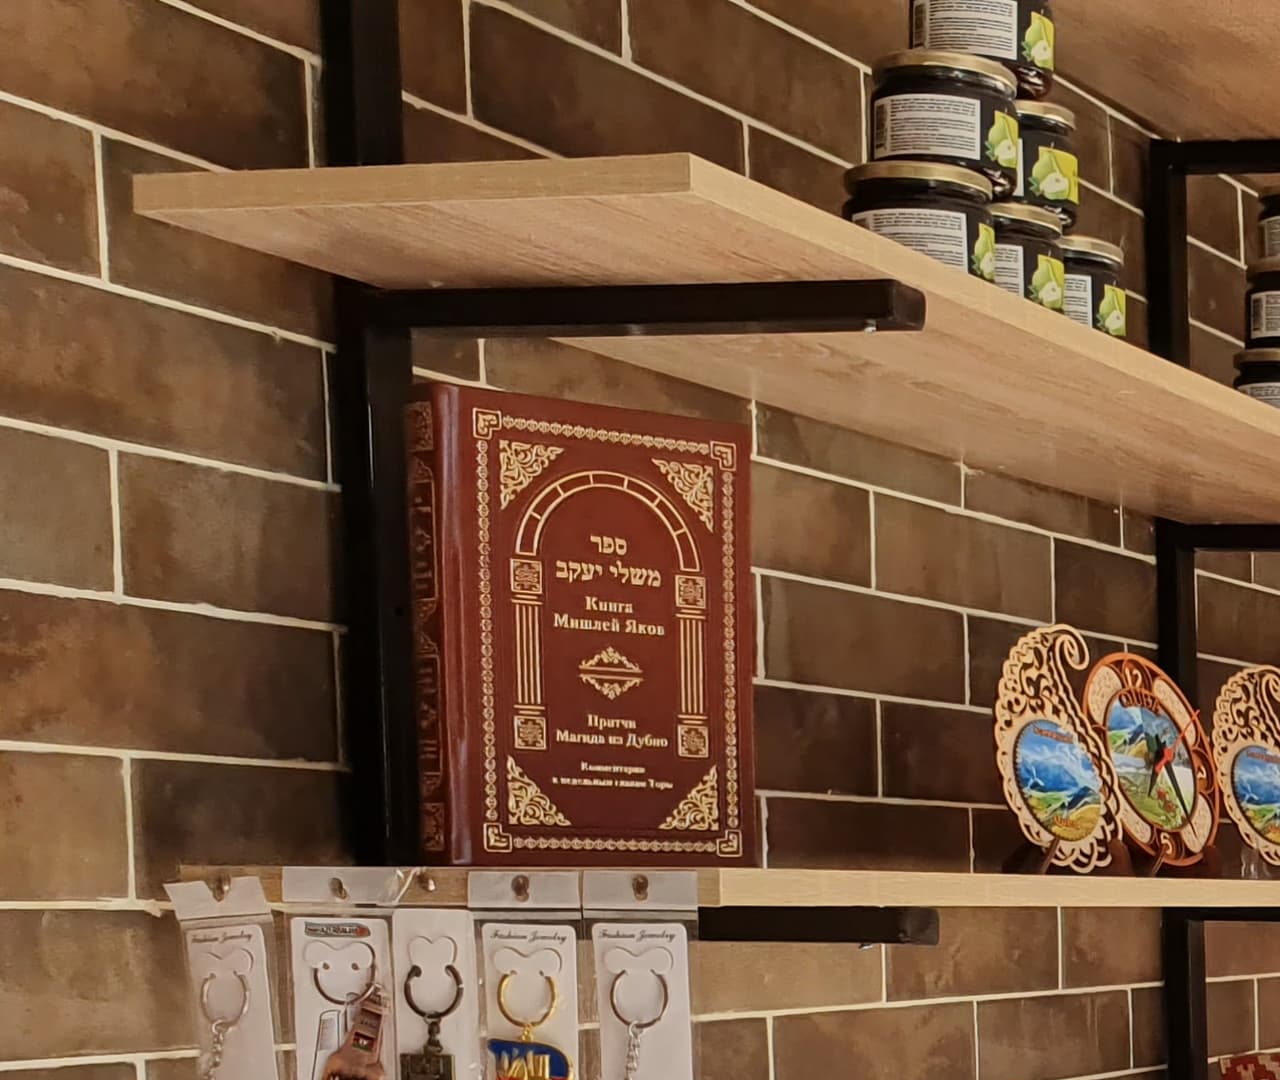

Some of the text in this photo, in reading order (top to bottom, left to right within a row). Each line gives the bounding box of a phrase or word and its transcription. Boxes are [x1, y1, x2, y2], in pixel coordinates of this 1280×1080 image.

[590, 534, 627, 555] ספר
[555, 560, 662, 587] משלי יעקב
[585, 596, 633, 614] Книга
[554, 613, 665, 636] Мишлей Яков
[587, 713, 636, 730] Притчи
[556, 729, 605, 745] Магида
[626, 734, 668, 748] Дубно
